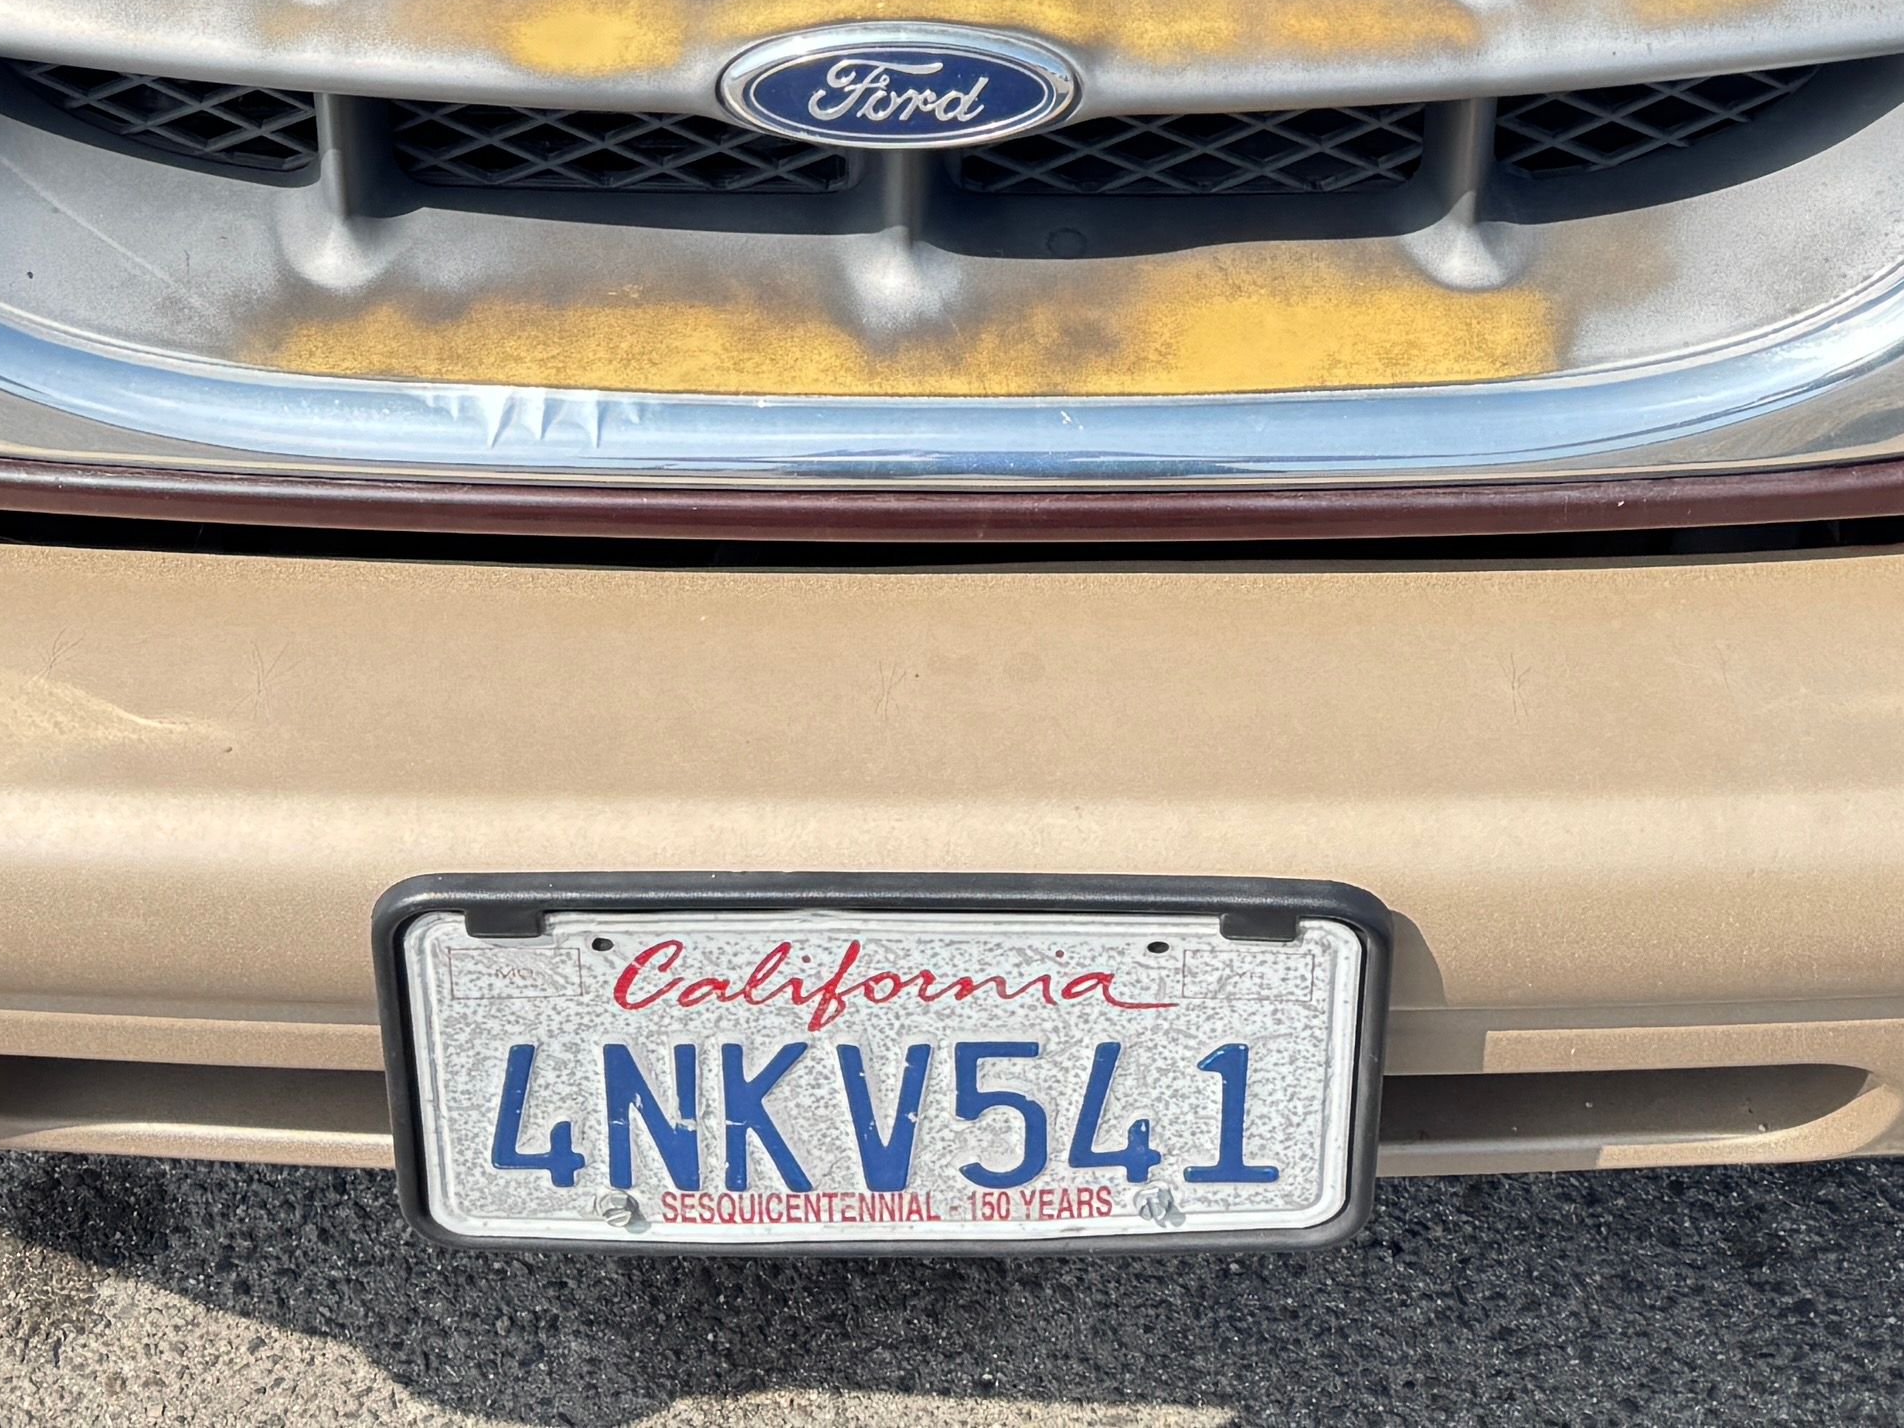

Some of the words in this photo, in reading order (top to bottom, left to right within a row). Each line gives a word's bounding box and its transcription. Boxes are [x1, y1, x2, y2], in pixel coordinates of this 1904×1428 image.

[807, 58, 990, 123] Ford
[612, 938, 1178, 1033] California
[490, 1040, 1281, 1193] 4NKV541
[660, 1189, 943, 1226] SESQUICENTENNIAL
[966, 1190, 1014, 1223] 150
[1018, 1186, 1114, 1222] YEARS
